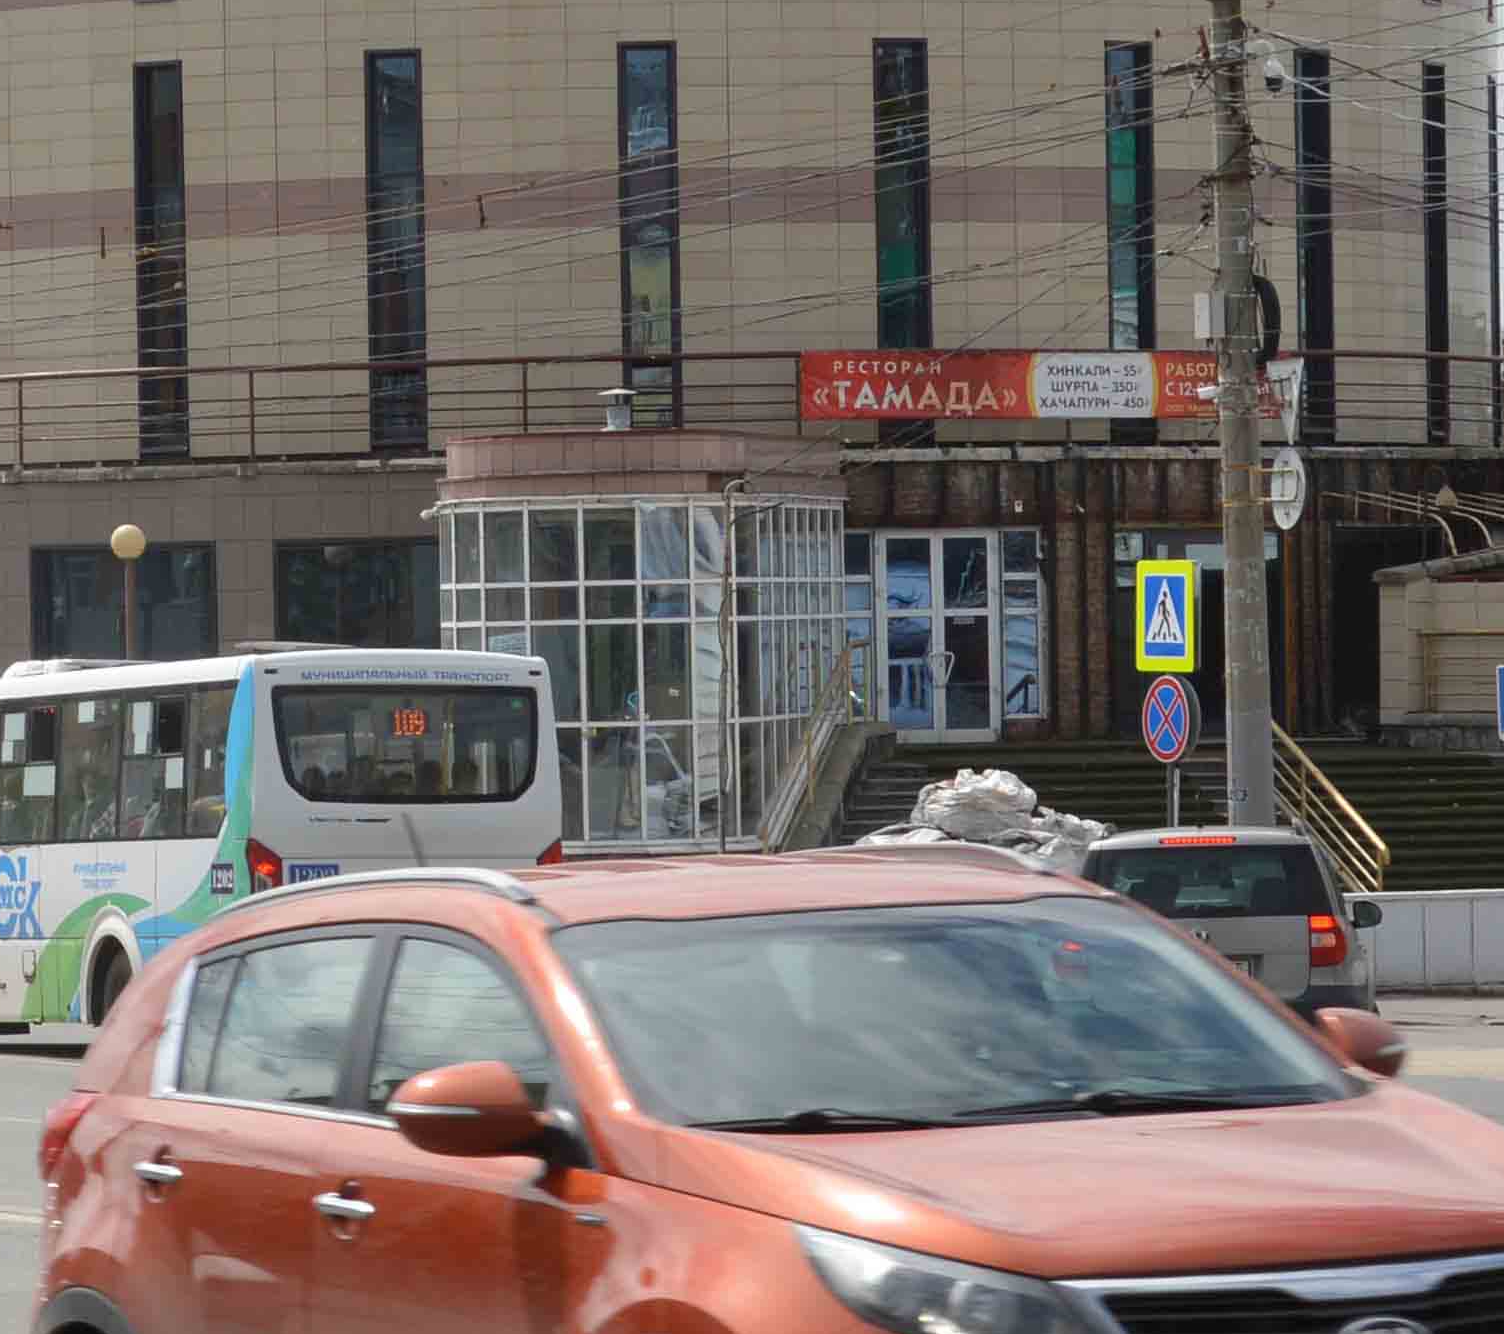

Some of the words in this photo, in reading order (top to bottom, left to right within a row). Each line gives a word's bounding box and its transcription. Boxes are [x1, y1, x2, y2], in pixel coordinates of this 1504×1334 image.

[833, 361, 941, 375] РЕСТОРАН
[1047, 365, 1110, 376] ХИНКАЛИ
[1166, 362, 1218, 377] РАБОТ
[1051, 381, 1098, 393] ШУРПА
[812, 380, 1017, 416] «ТАМАДА»
[1040, 397, 1110, 409] ХАЧАПУРИ
[301, 668, 427, 681] МУНИЦИПАЛЬНЫЙ
[435, 671, 512, 683] ТРАНСПОРТ
[393, 708, 426, 736] 109
